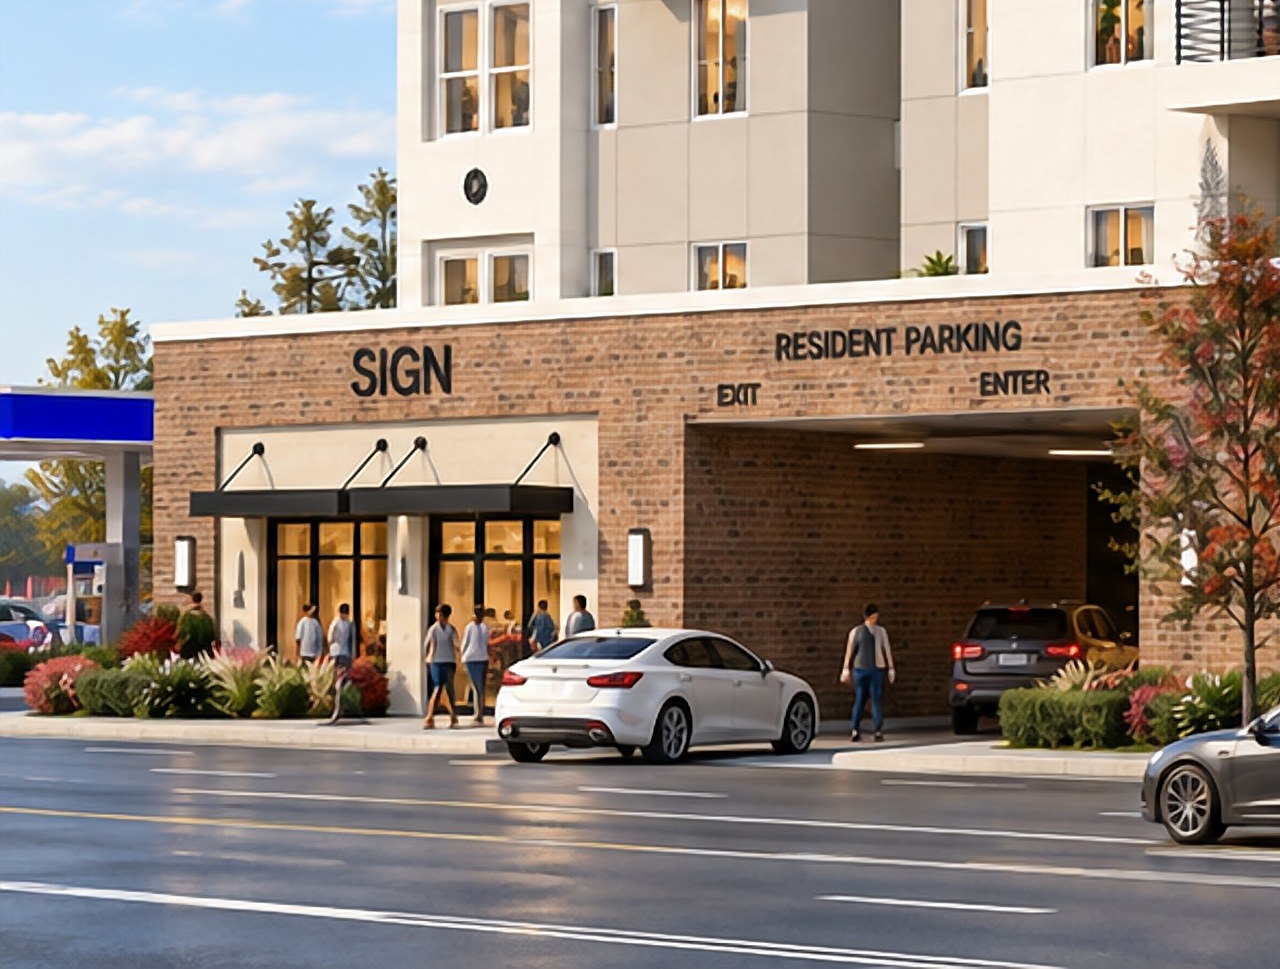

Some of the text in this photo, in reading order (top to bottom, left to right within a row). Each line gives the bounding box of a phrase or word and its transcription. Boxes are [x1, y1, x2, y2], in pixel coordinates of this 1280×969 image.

[775, 320, 1022, 362] RESIDENT PARKING
[351, 344, 452, 397] SIGN
[980, 370, 1050, 396] ENTER
[717, 382, 761, 407] EXIT
